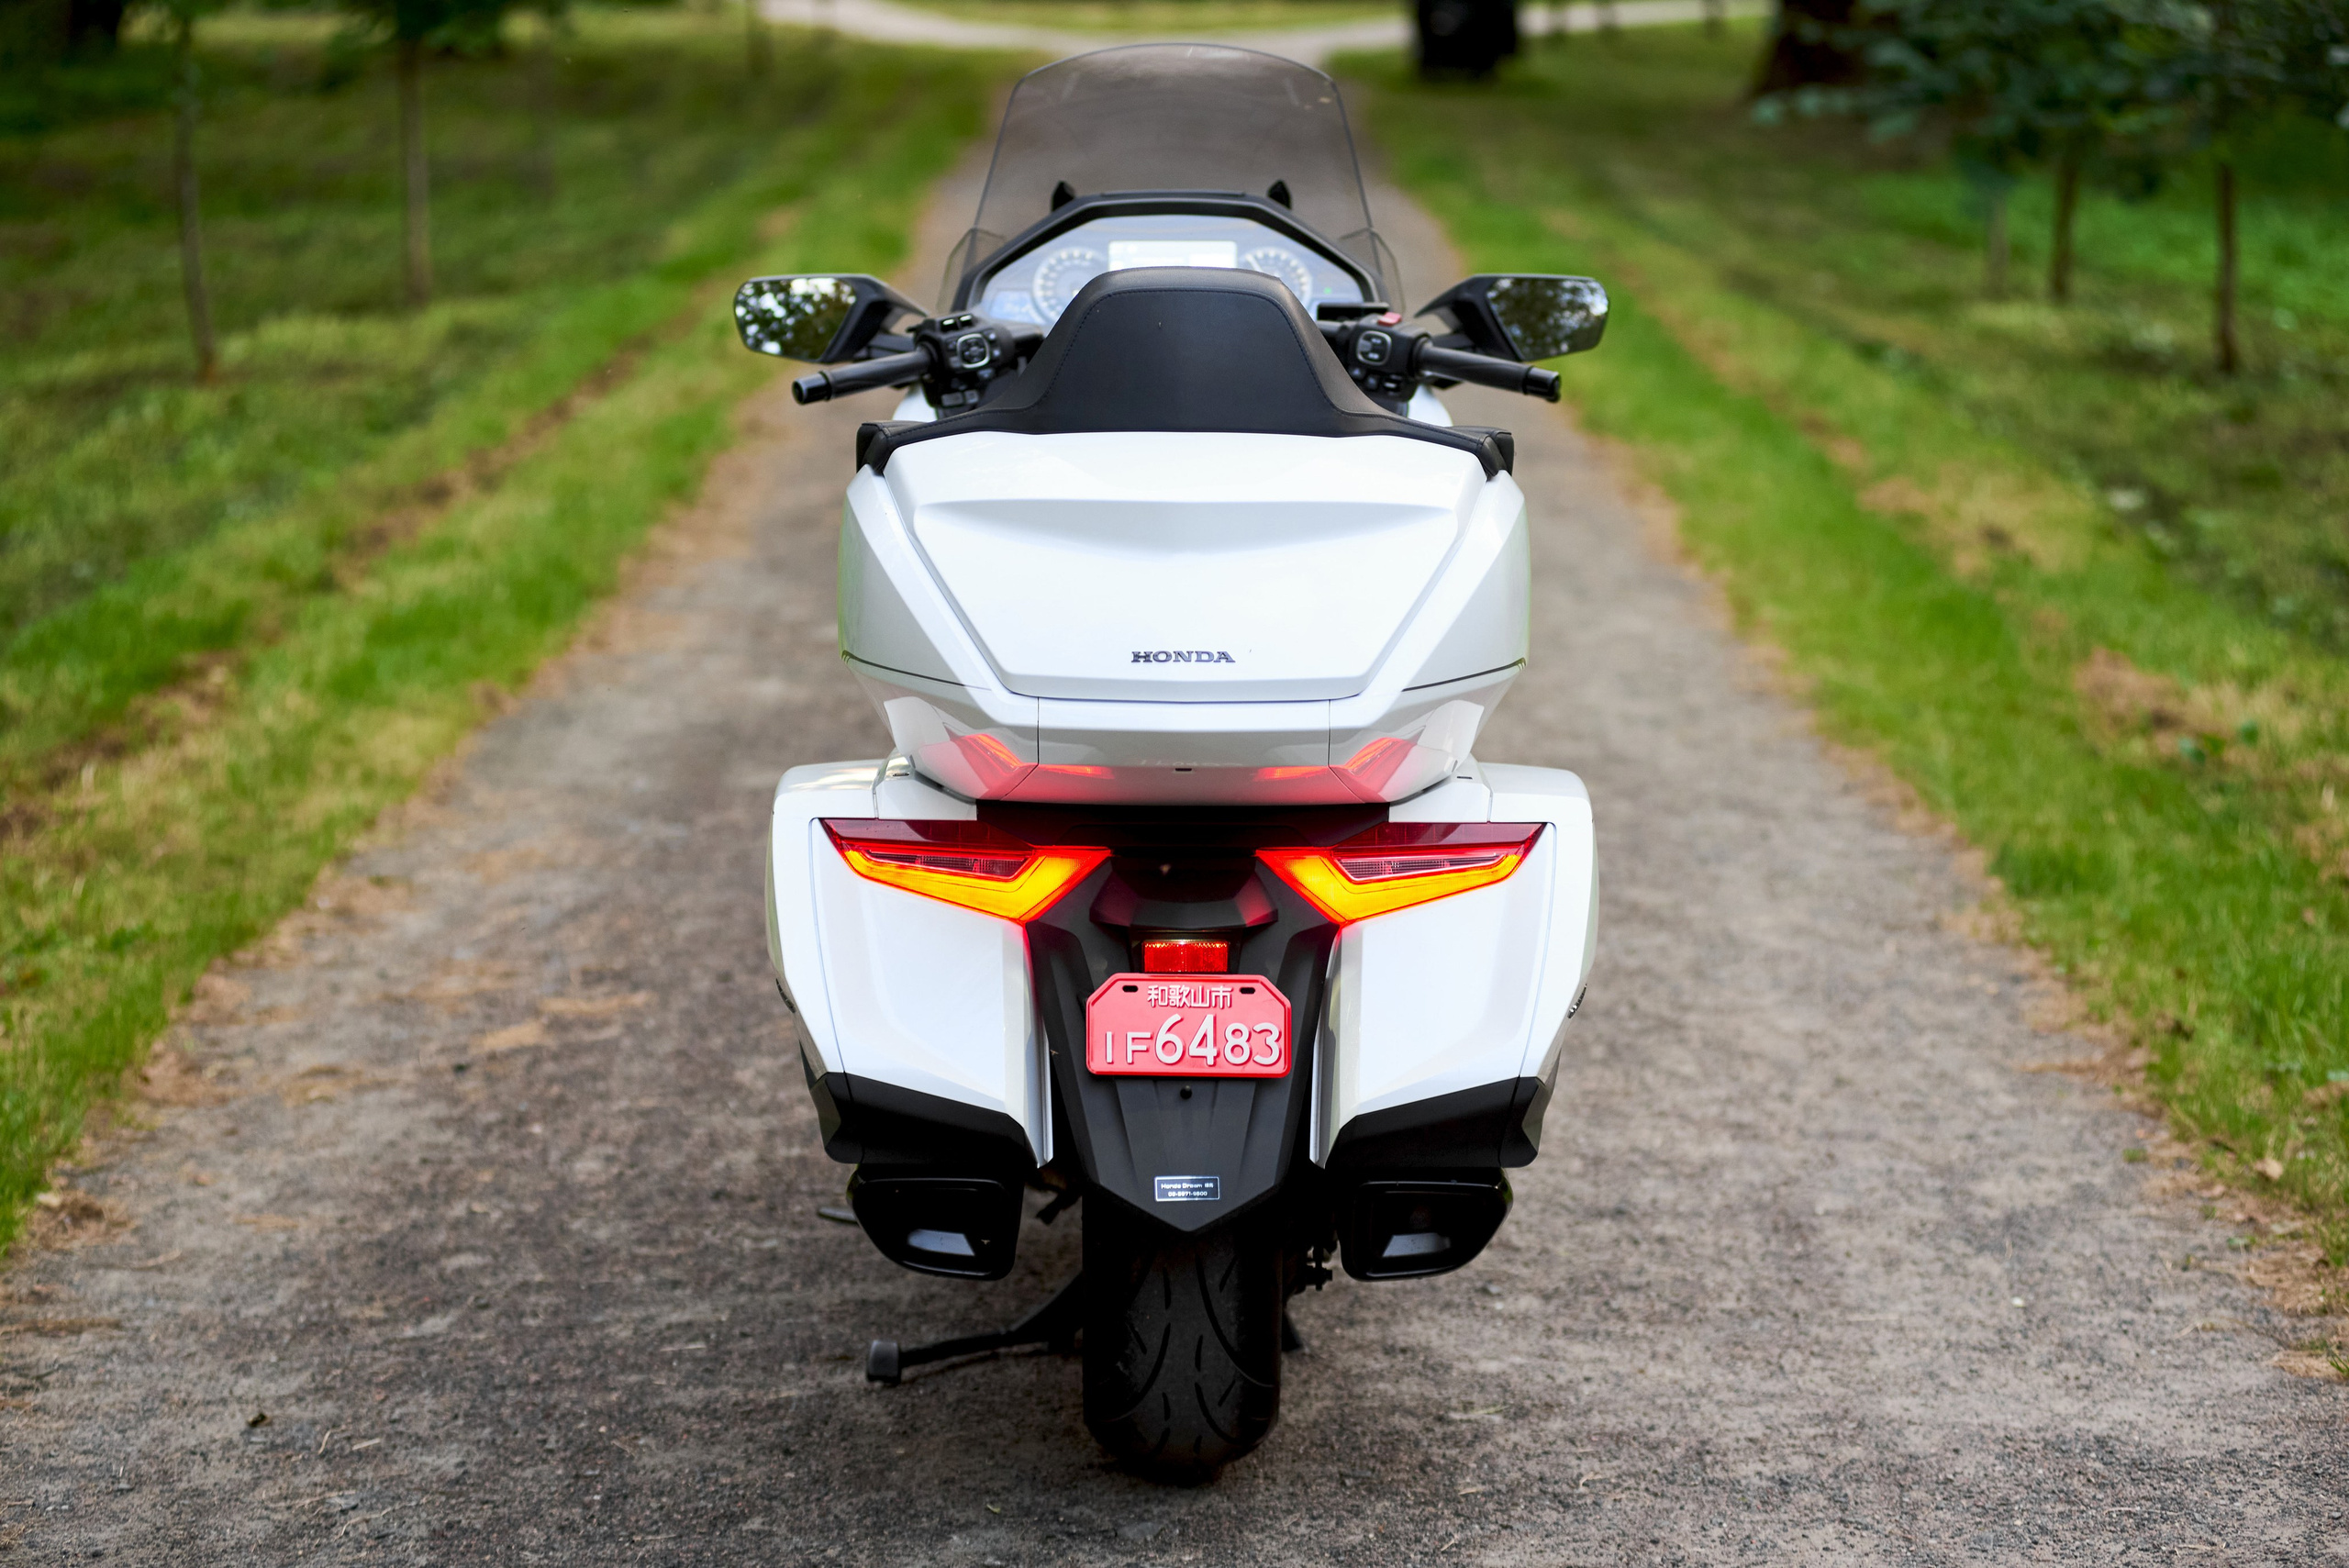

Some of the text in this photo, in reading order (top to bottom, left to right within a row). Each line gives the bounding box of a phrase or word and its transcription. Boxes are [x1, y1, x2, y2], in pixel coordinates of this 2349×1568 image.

[1131, 651, 1236, 663] HONDA
[1147, 984, 1233, 1008] 和歌山市
